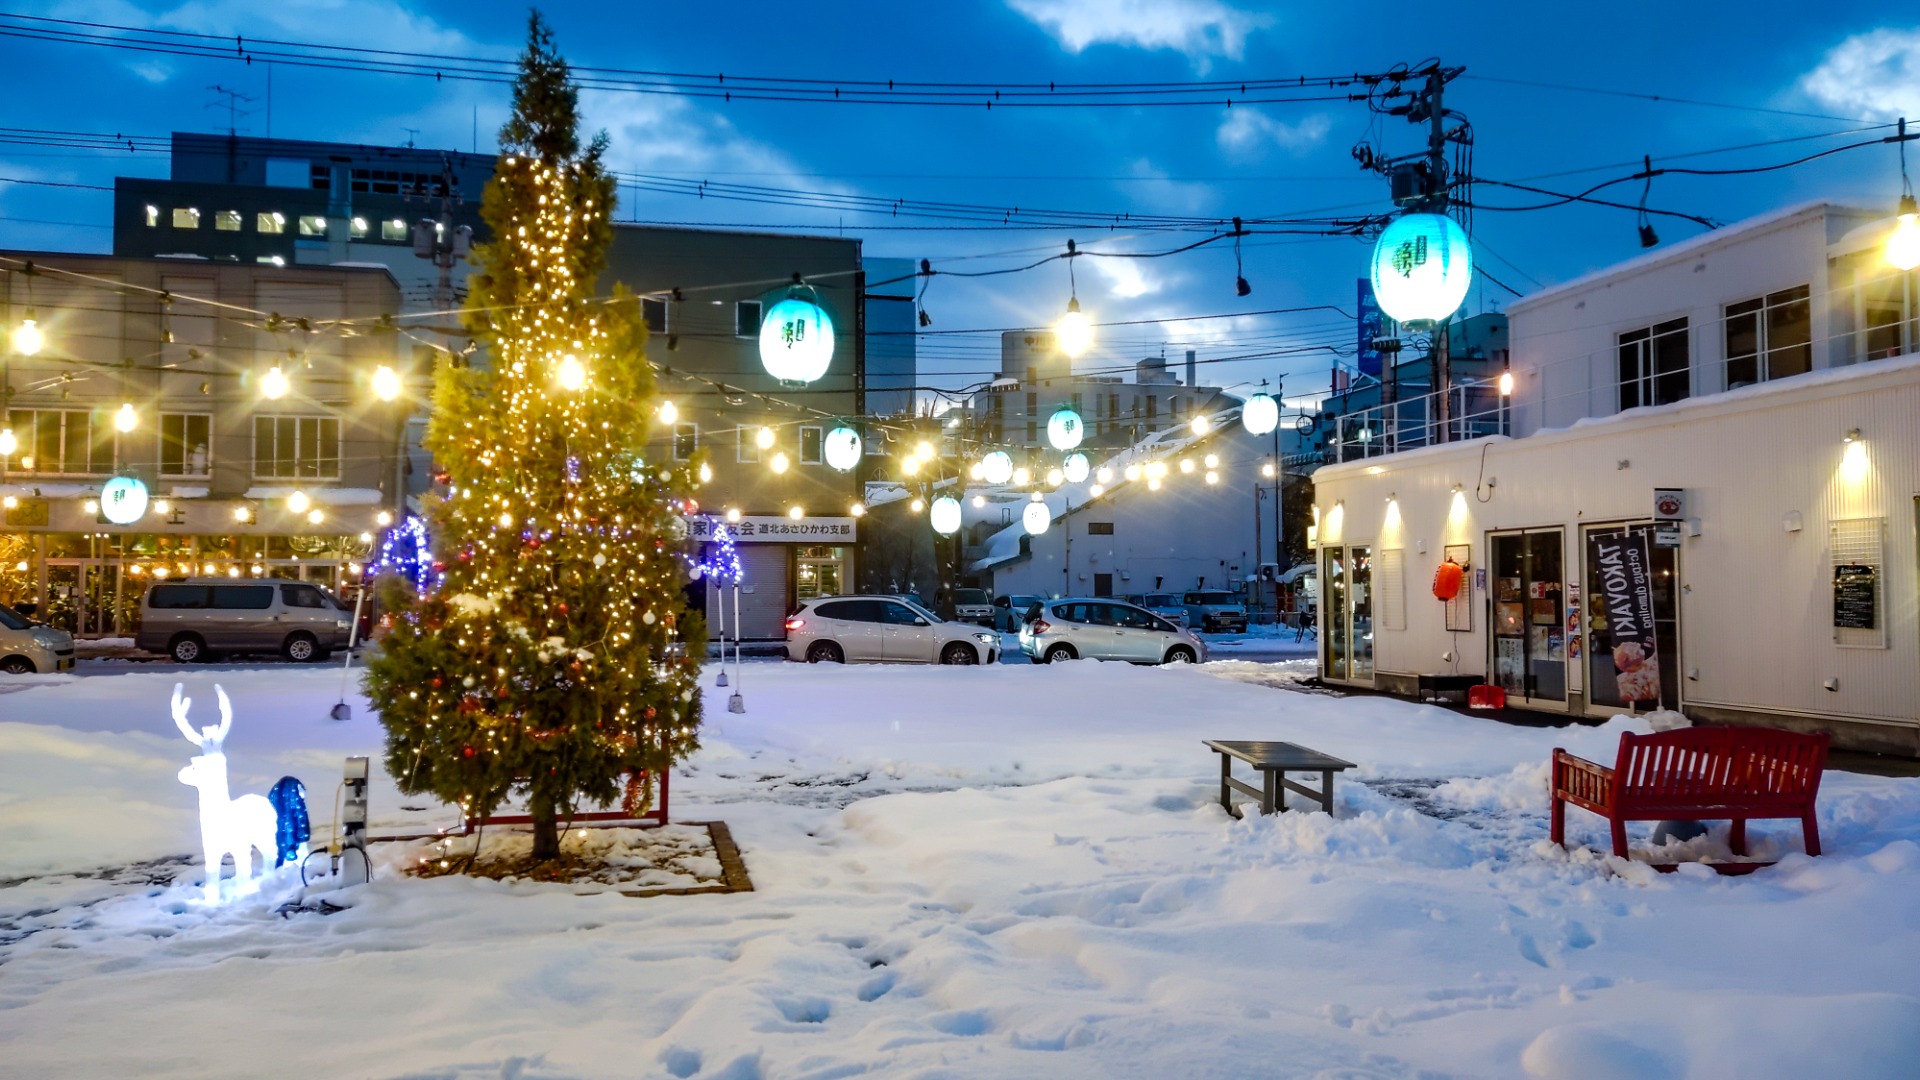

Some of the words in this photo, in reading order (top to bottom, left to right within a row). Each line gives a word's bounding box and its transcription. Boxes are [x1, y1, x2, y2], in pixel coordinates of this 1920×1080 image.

[758, 523, 851, 535] 道北あさひかわ支部
